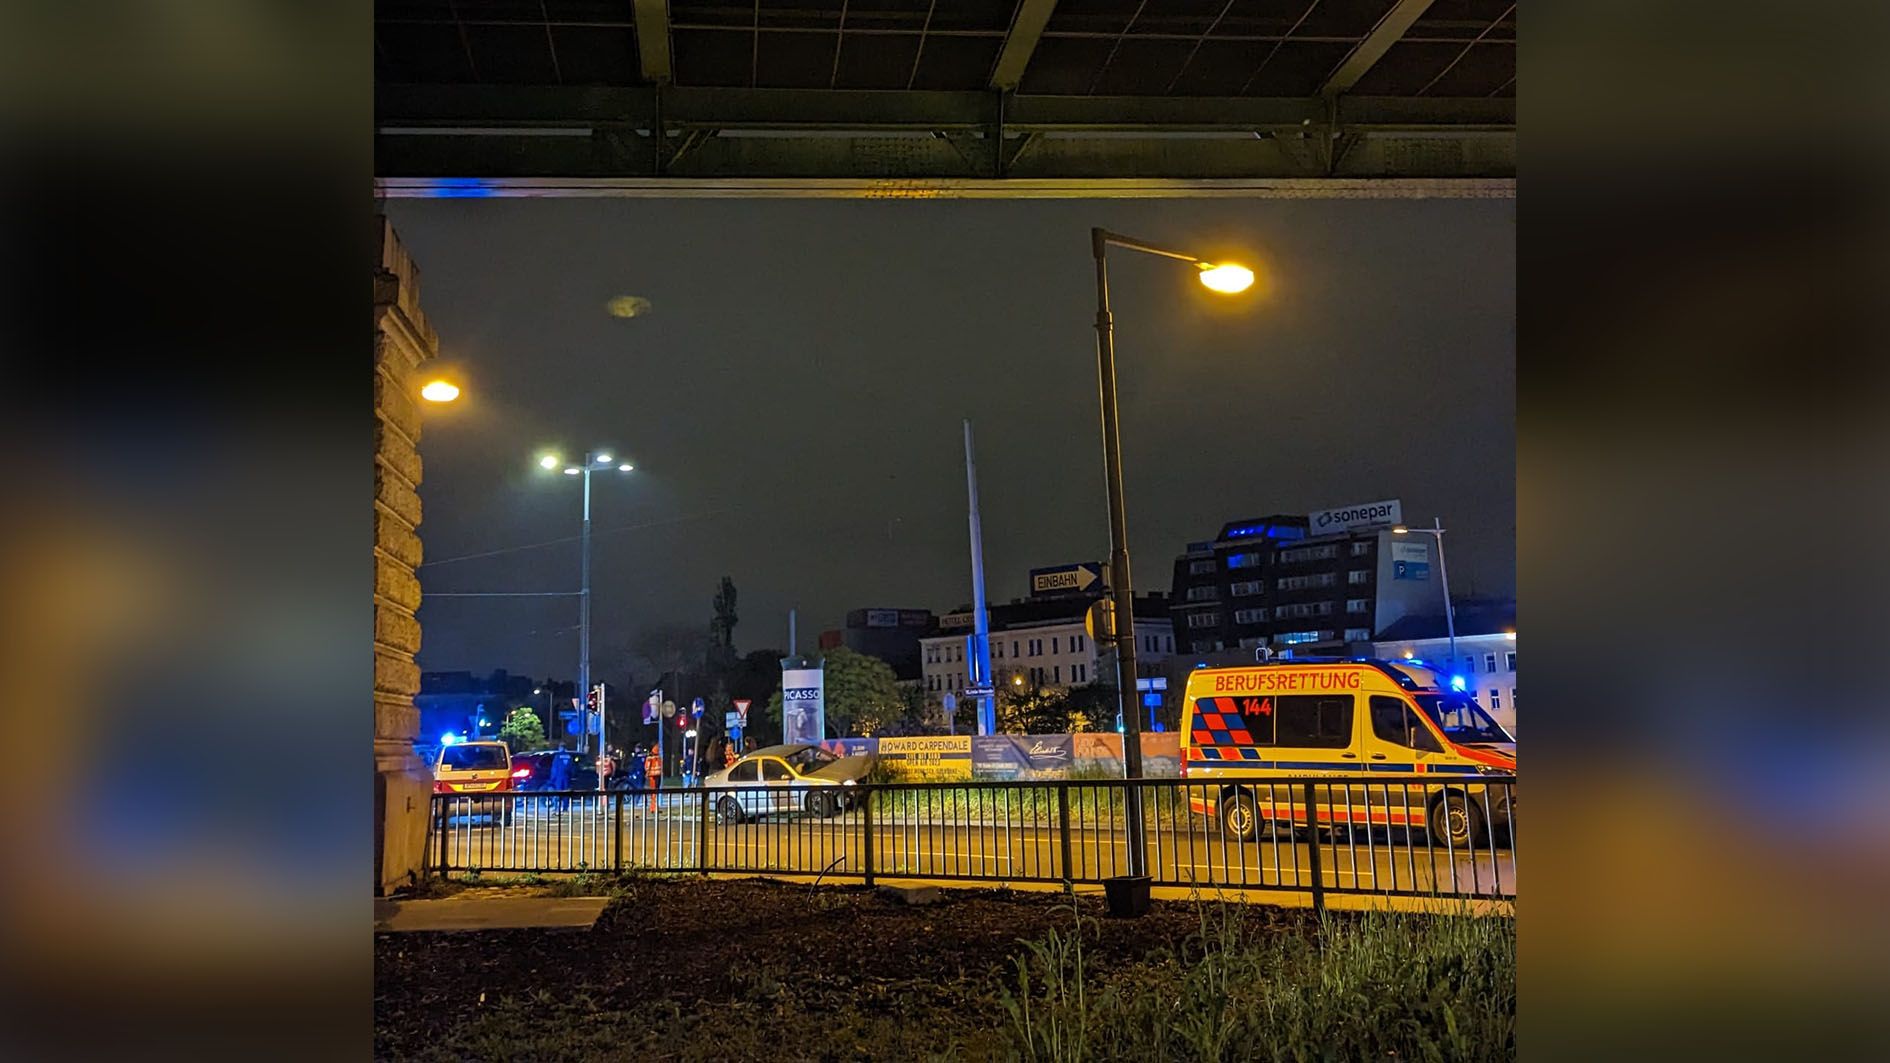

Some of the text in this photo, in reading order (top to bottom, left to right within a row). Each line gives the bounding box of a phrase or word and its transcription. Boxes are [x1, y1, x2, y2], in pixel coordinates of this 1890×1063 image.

[1334, 504, 1392, 523] sonepar
[1037, 573, 1077, 589] EINBAHN
[1215, 672, 1360, 691] BERUFSRETTUNG
[1243, 698, 1272, 716] 144
[881, 741, 917, 752] HOWARD
[919, 740, 968, 751] CARPENDALE
